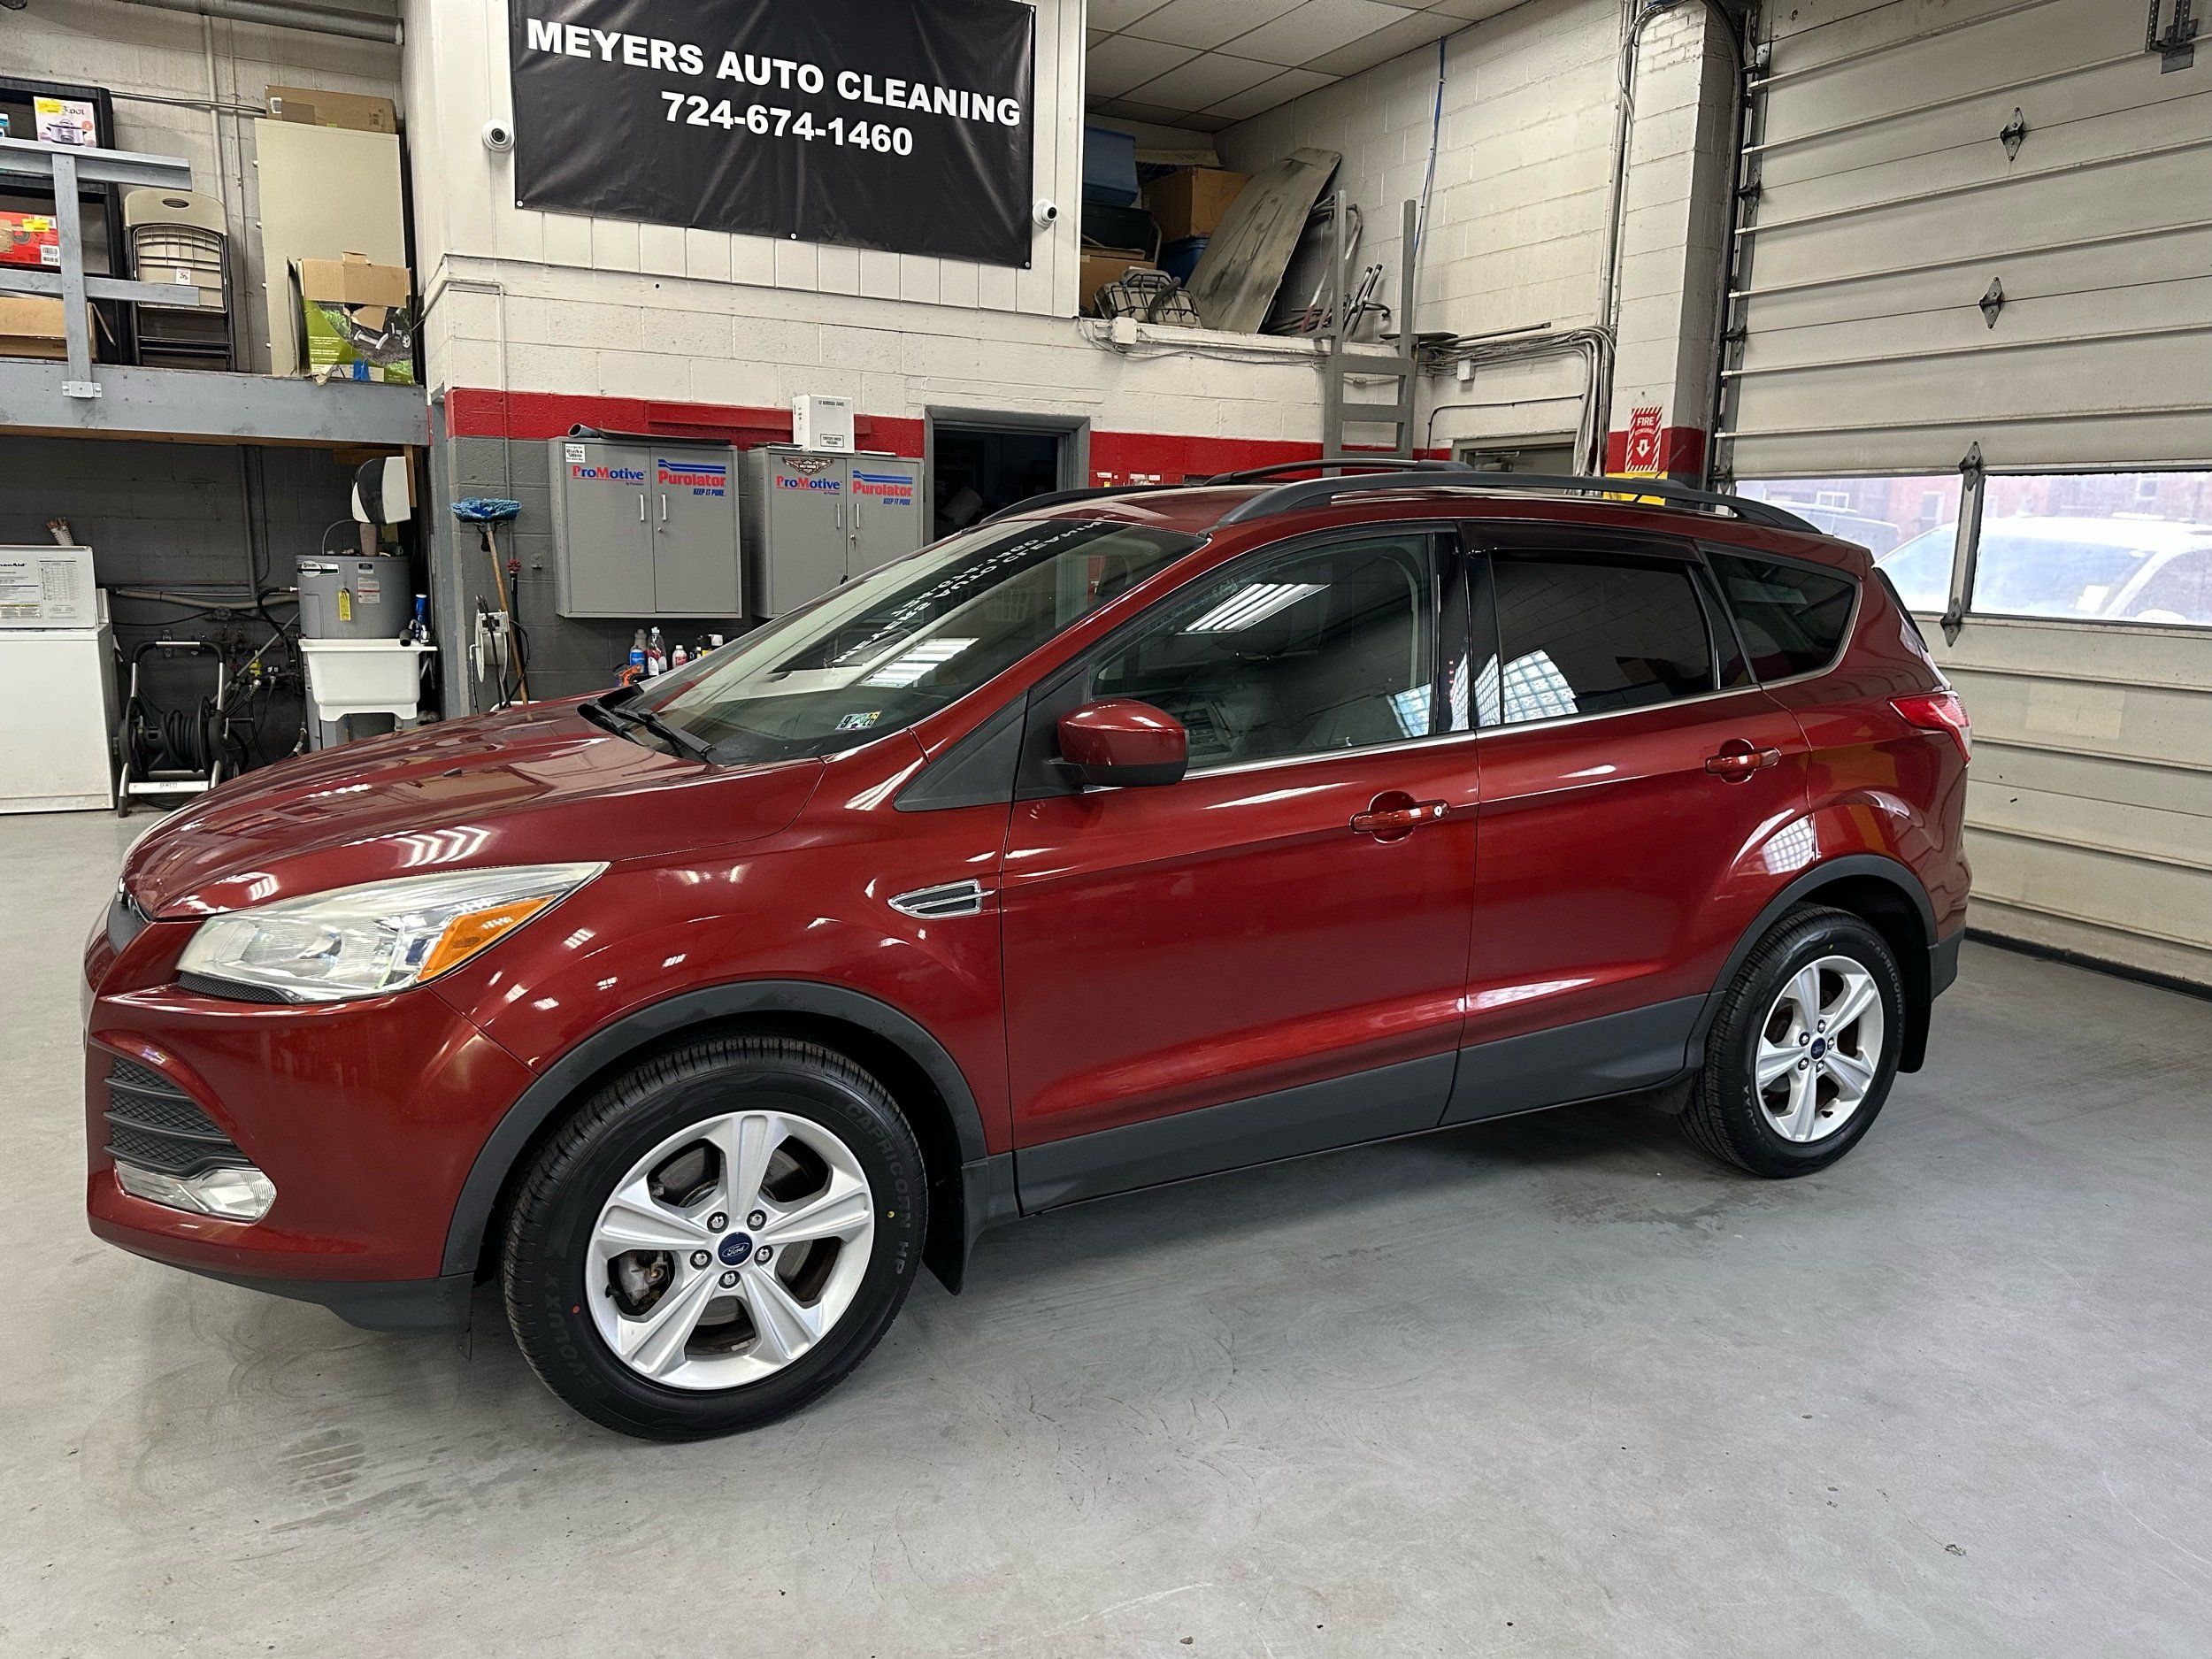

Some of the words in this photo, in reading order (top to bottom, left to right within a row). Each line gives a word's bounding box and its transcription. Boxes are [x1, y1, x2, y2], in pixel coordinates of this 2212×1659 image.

[526, 19, 704, 76] MEYERS
[717, 50, 825, 95] AUTO
[836, 71, 1021, 127] CLEANING
[661, 91, 914, 157] 724-674-1460
[1636, 416, 1655, 426] FIRE
[572, 465, 644, 480] ProMotive
[658, 470, 726, 487] Purolator
[776, 475, 840, 489] ProMotive
[853, 480, 912, 496] Purolator
[896, 1240, 910, 1275] HP
